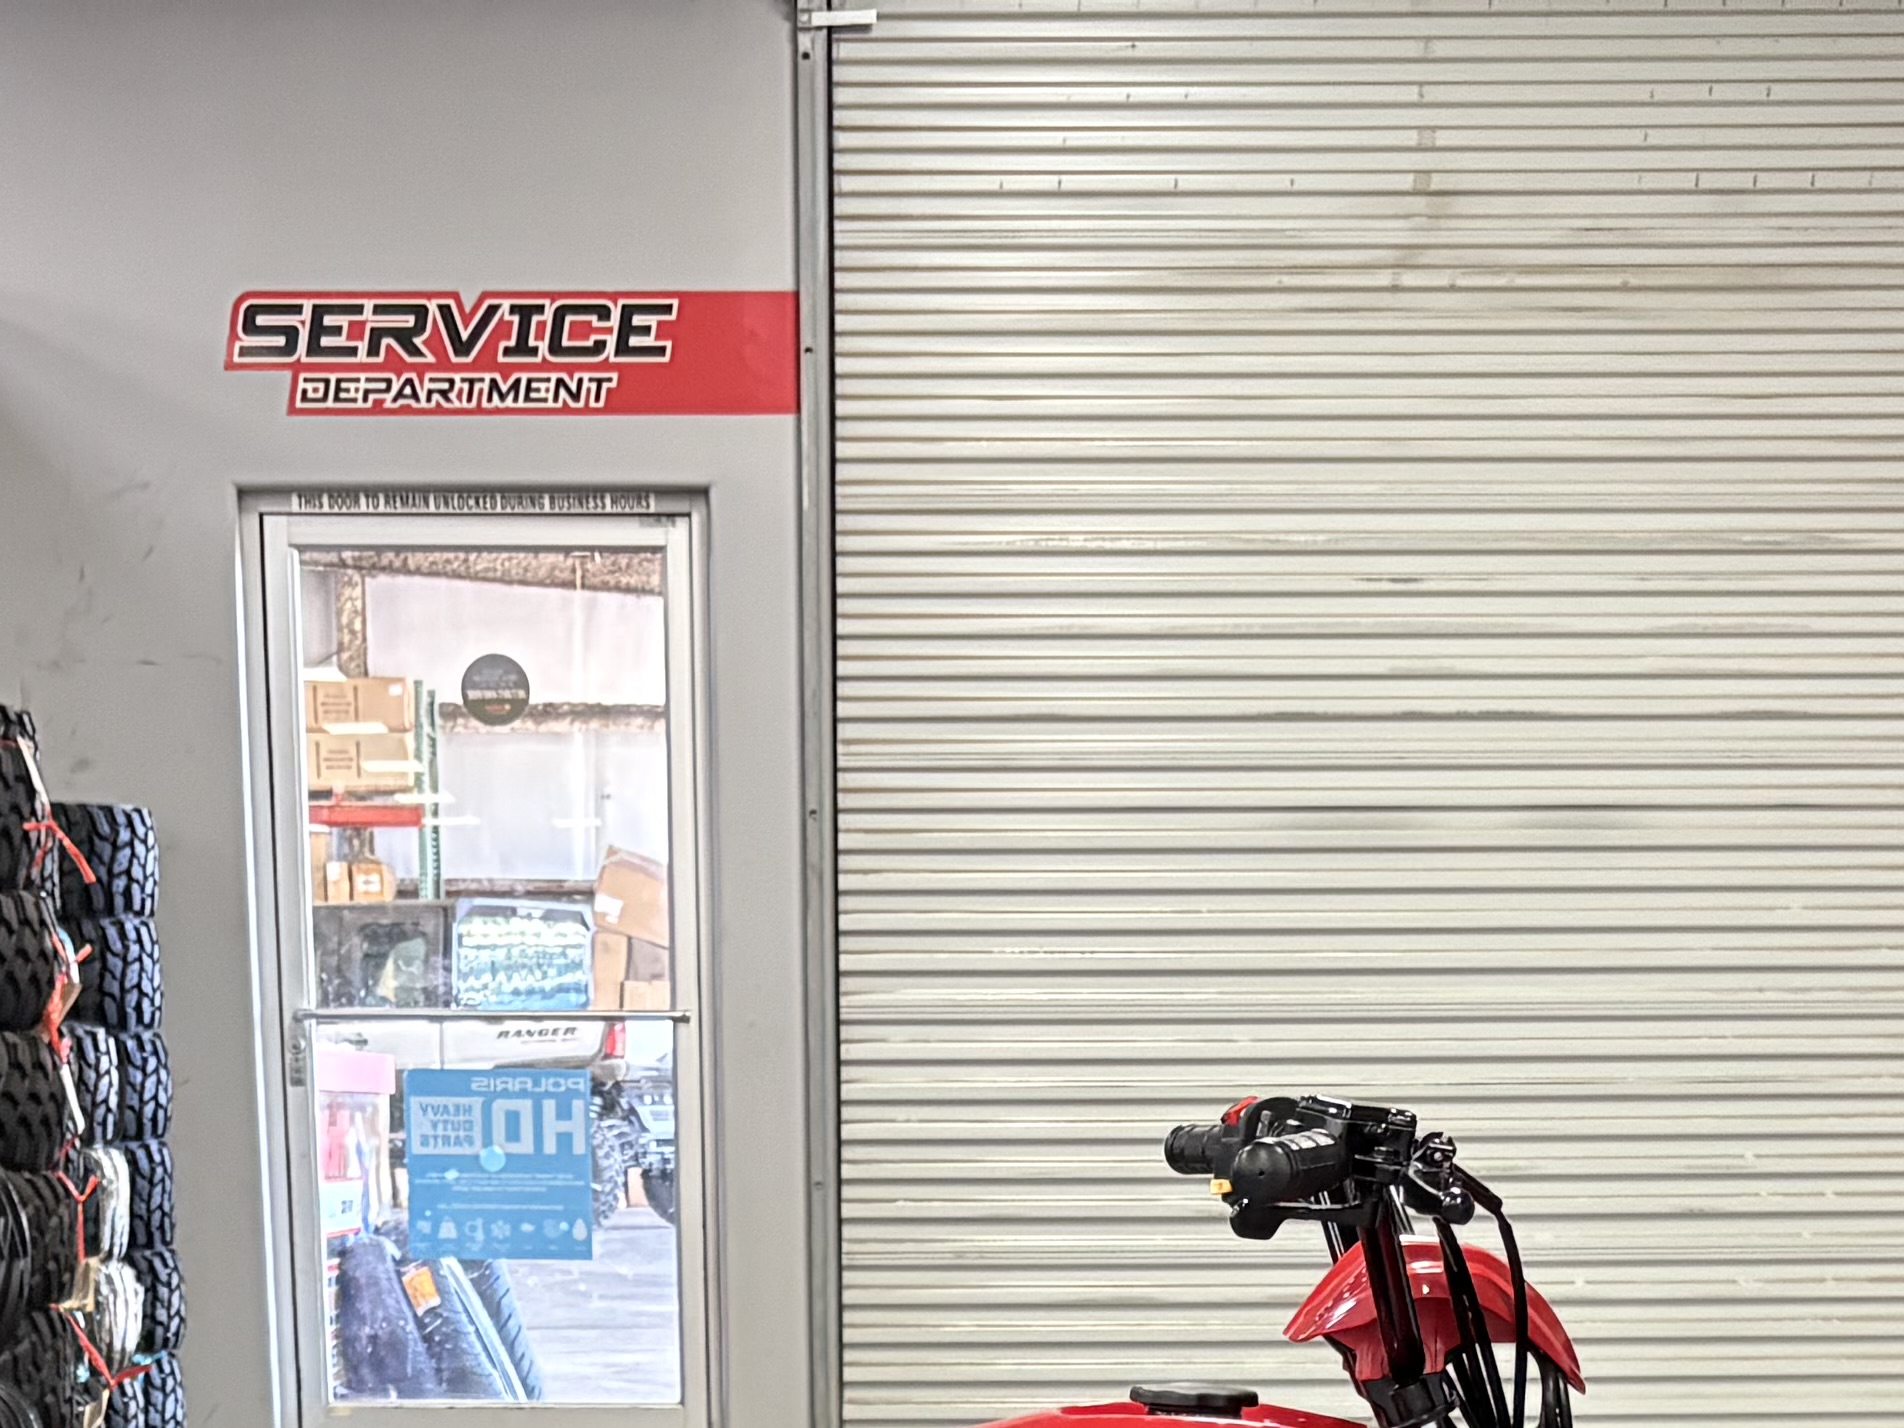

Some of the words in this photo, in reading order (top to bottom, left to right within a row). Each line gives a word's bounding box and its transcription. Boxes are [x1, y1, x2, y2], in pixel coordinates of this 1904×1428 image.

[233, 298, 679, 363] SERVICE
[296, 371, 619, 409] DEPARTMENT
[297, 491, 324, 512] THIS
[327, 491, 362, 512] DOOR
[366, 491, 381, 512] TO
[384, 491, 430, 512] REMAIN
[433, 491, 496, 512] UNLOCKED
[500, 491, 545, 512] DURING
[549, 491, 607, 512] BUSINESS
[610, 491, 651, 512] HOURS
[497, 1026, 578, 1041] RANGER
